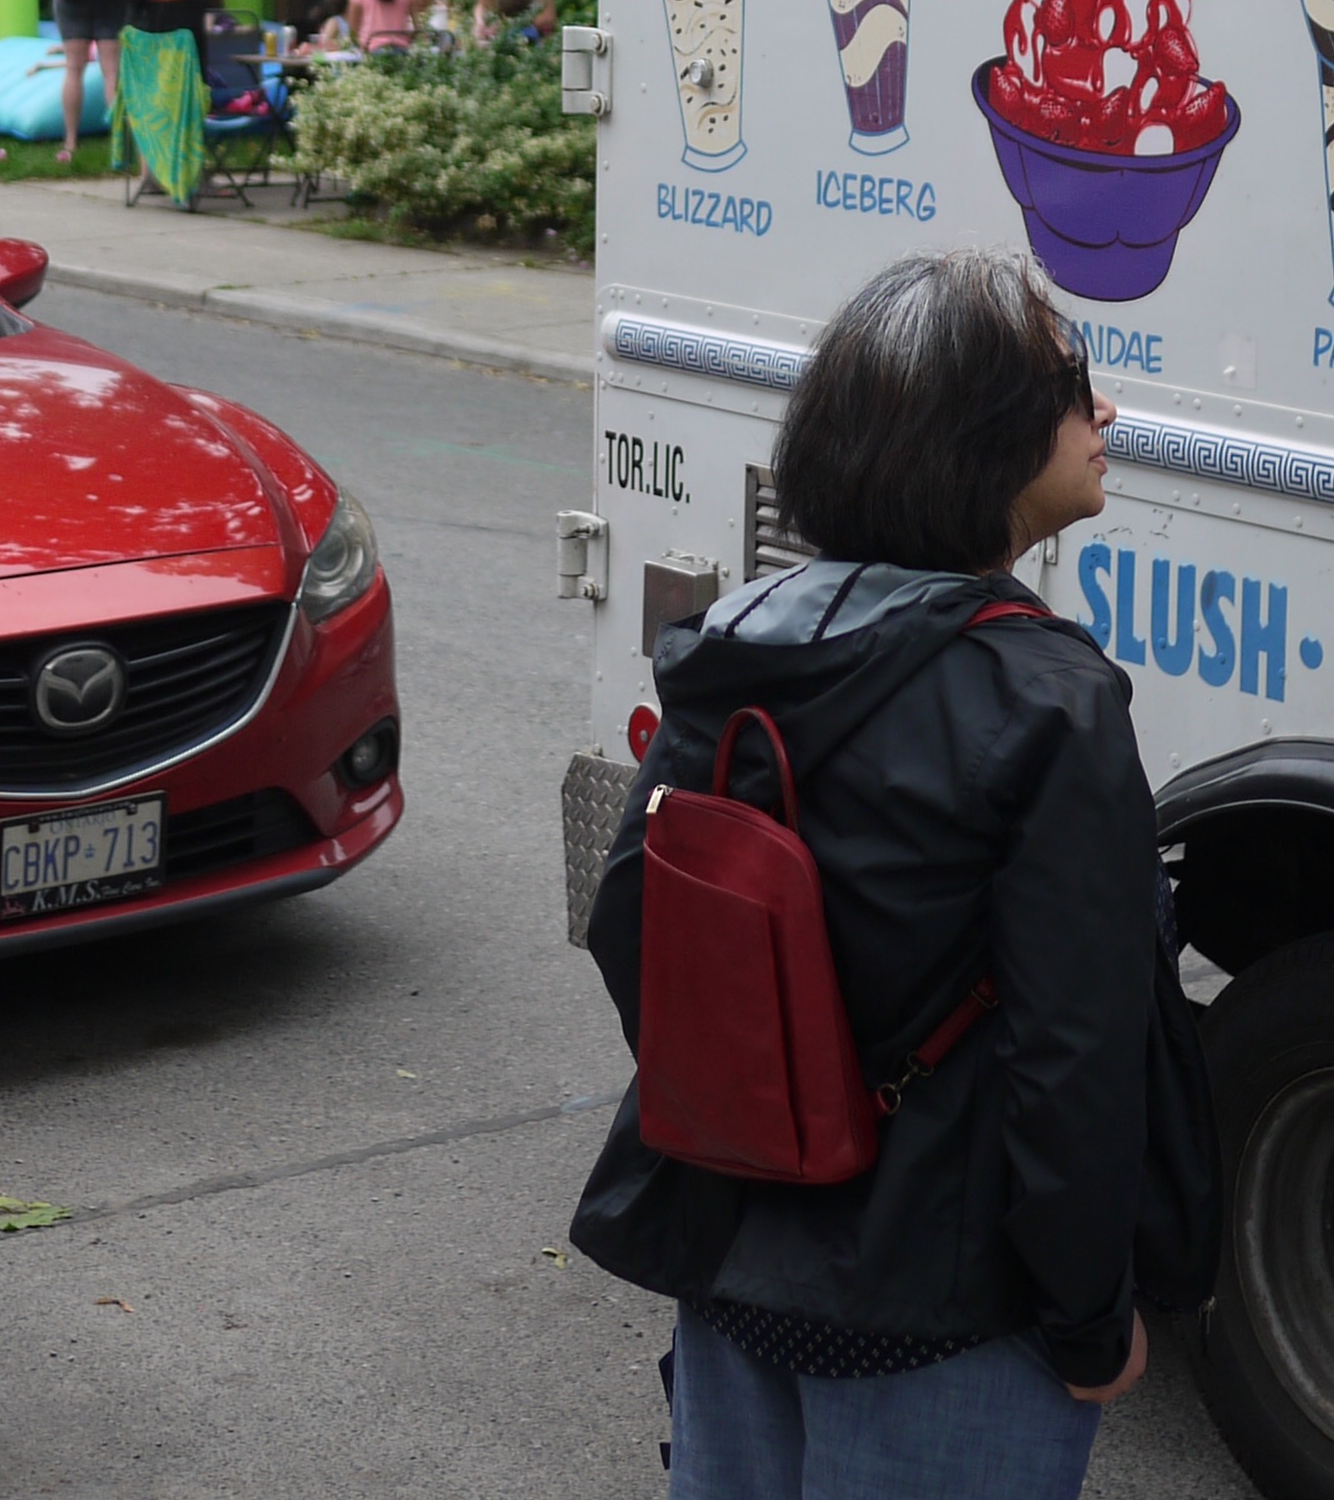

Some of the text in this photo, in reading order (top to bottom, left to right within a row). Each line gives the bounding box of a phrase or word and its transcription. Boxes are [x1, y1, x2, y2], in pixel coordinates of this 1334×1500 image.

[657, 183, 773, 236] BLIZZARD
[816, 170, 936, 222] ICEBERG
[1078, 541, 1288, 703] SLUSH
[4, 821, 158, 889] CBKP 713
